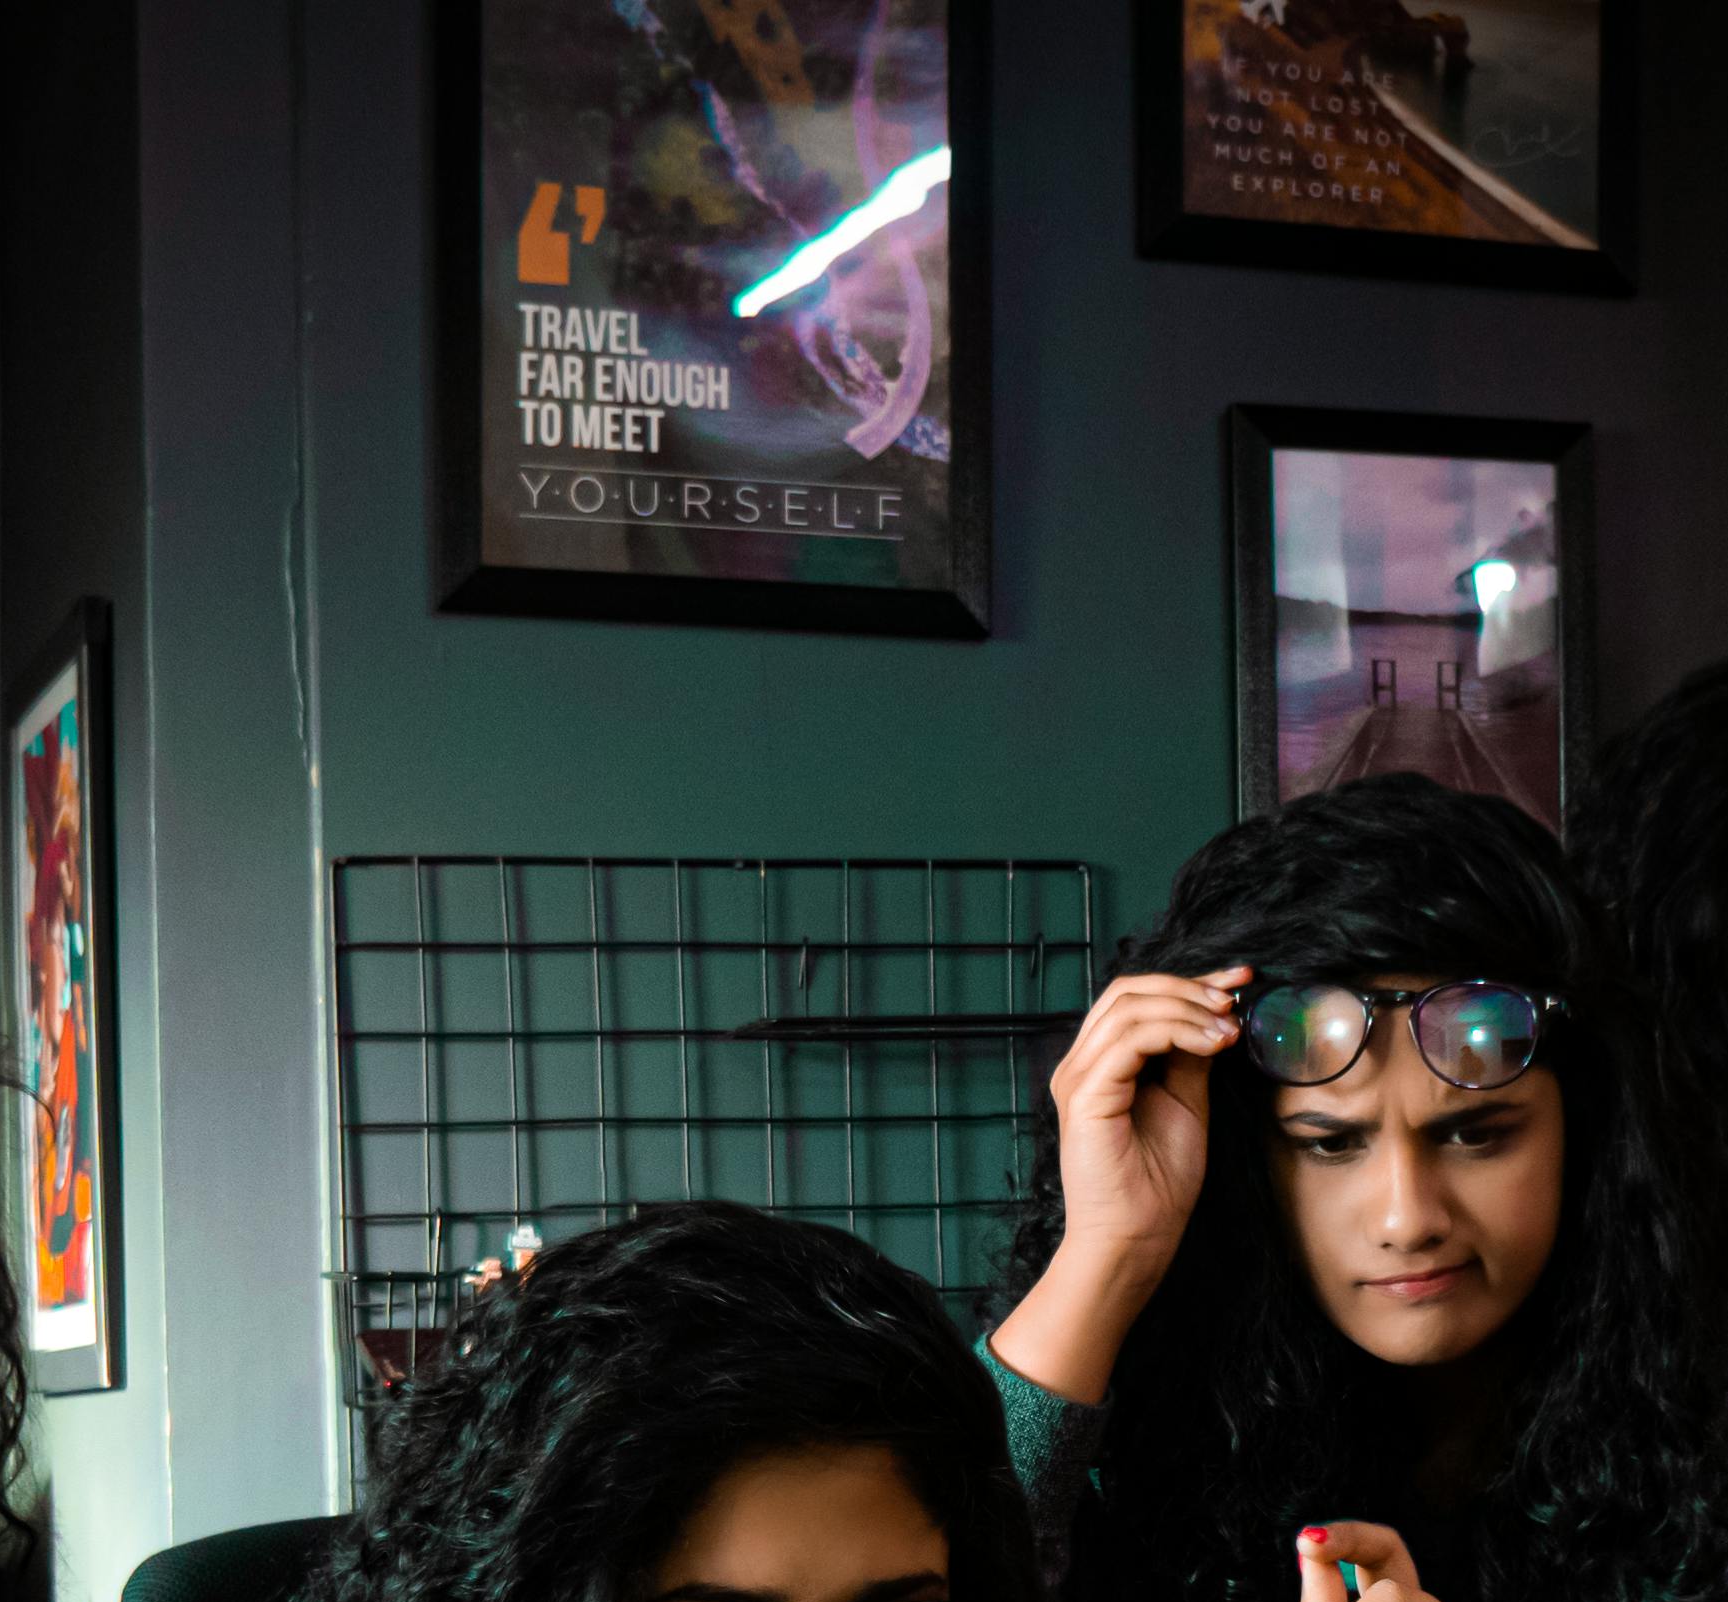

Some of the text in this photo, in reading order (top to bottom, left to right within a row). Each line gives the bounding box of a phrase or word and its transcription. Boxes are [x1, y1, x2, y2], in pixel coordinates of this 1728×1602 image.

[1223, 56, 1394, 89] IF YOU ARE
[1238, 87, 1380, 116] NOT LOST
[1206, 113, 1408, 147] YOU ARE NOT
[1215, 143, 1401, 176] MUCH OF AN
[1232, 174, 1383, 202] EXPLORER
[518, 303, 648, 356] TRAVEL
[518, 352, 730, 410] FAR ENOUGH
[518, 400, 665, 453] TO MEET
